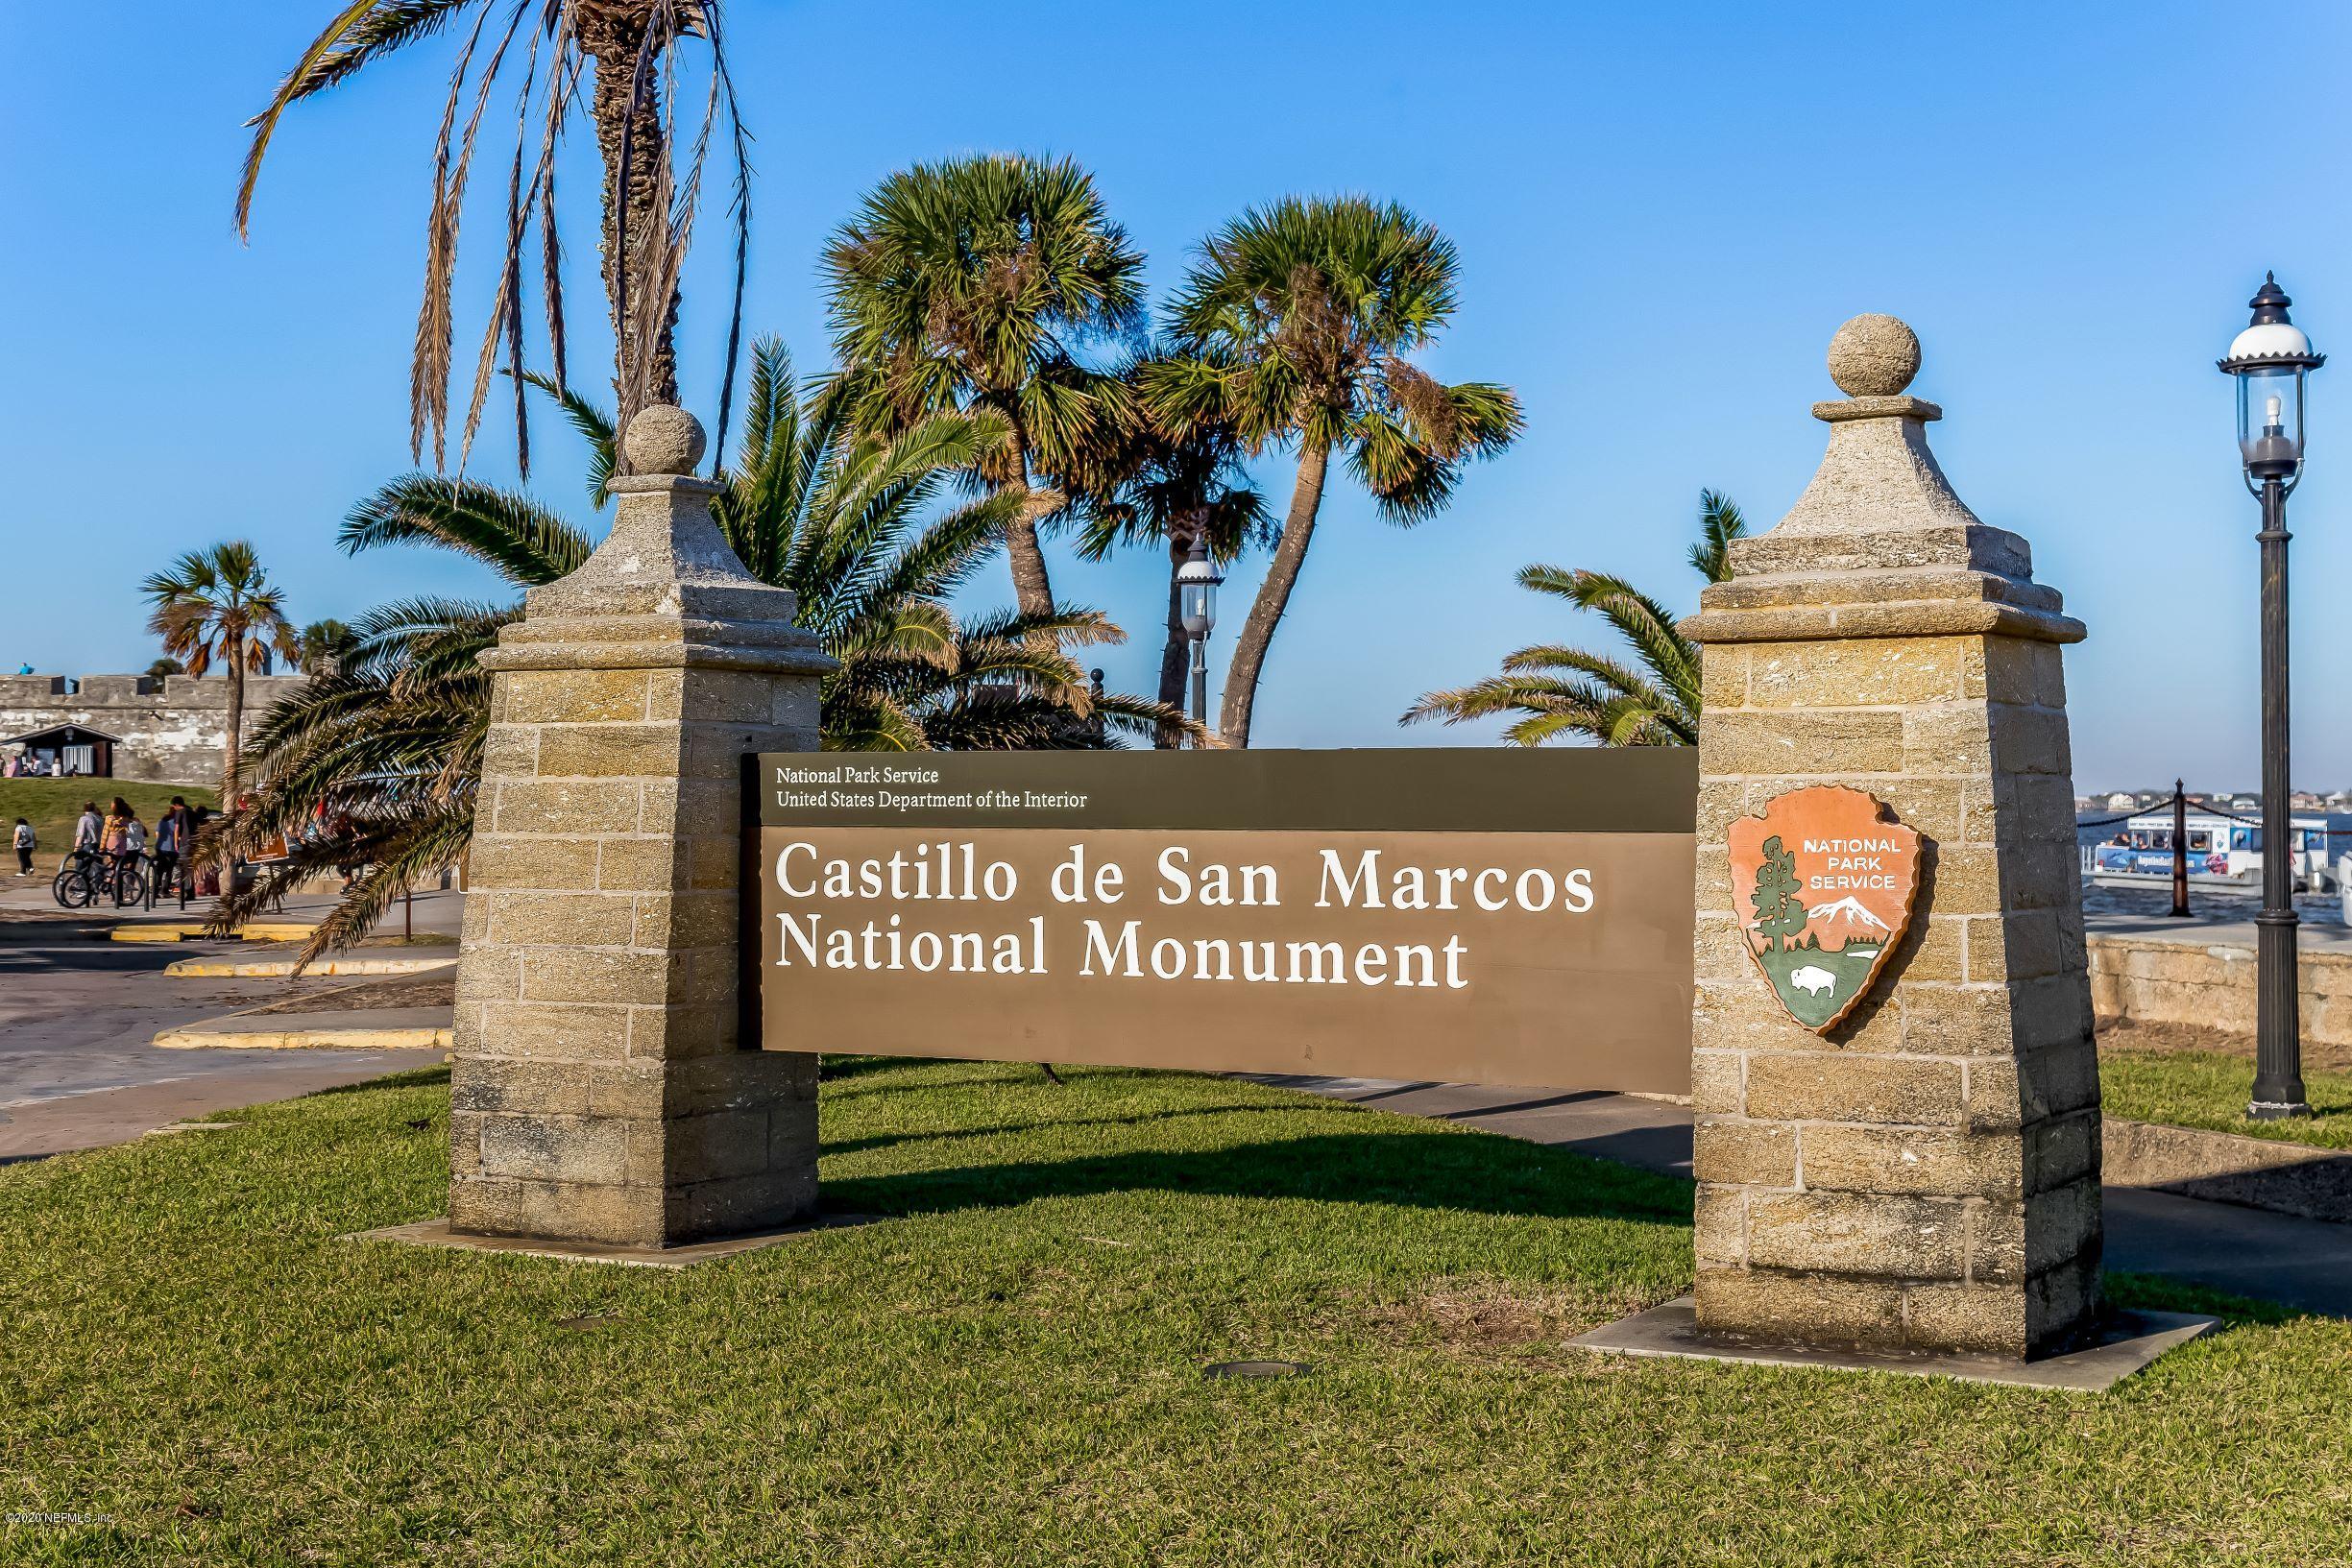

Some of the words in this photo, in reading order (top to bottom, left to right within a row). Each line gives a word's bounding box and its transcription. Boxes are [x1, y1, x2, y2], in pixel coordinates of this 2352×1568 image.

[776, 766, 841, 784] National
[844, 766, 881, 784] Park
[883, 766, 939, 784] Service
[776, 790, 828, 808] United
[830, 790, 875, 808] States
[878, 791, 973, 812] Department
[976, 789, 994, 808] of
[995, 790, 1021, 808] the
[1024, 790, 1088, 808] Interior
[1804, 838, 1902, 854] NATIONAL
[1828, 856, 1882, 871] PARK
[775, 841, 1018, 902] Castillo
[1050, 843, 1125, 905] de
[1156, 846, 1281, 906] San
[1314, 849, 1595, 913] Marcos
[1809, 874, 1896, 890] SERVICE
[775, 912, 1049, 975] National
[1079, 919, 1469, 989] Monument
